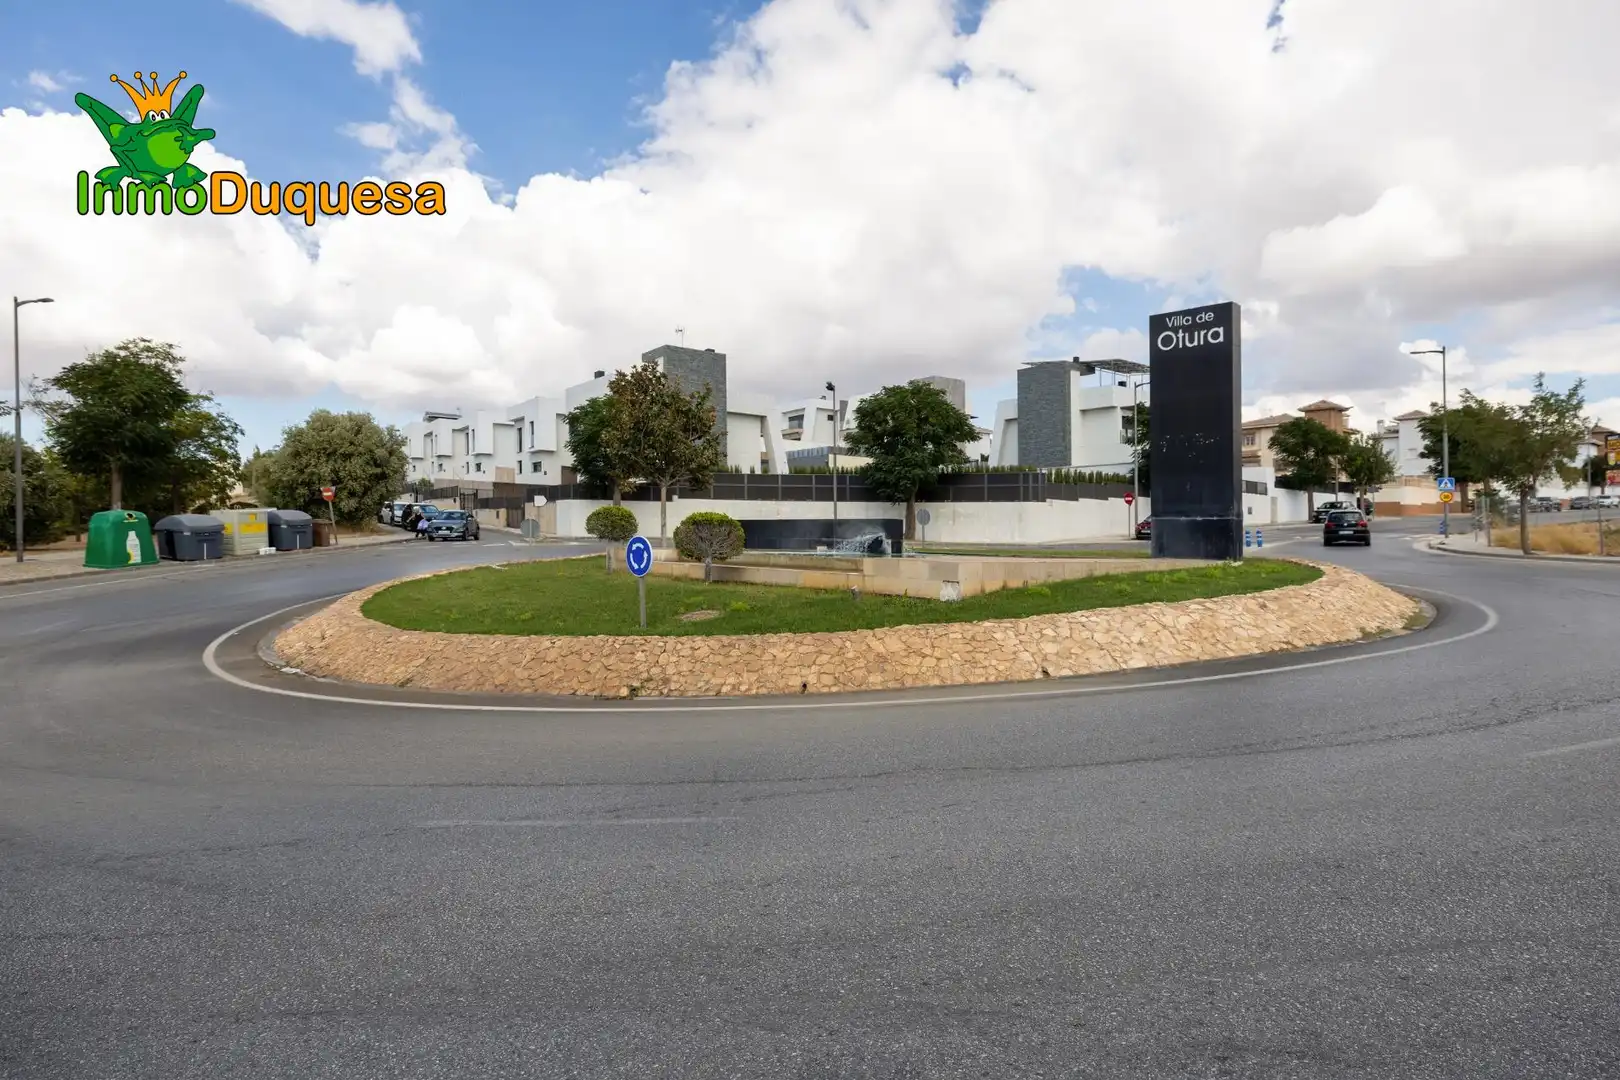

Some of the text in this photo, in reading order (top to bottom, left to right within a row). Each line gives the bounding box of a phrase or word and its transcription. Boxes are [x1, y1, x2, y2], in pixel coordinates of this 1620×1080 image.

[1166, 311, 1214, 328] Villa de
[1157, 326, 1224, 351] Otura
